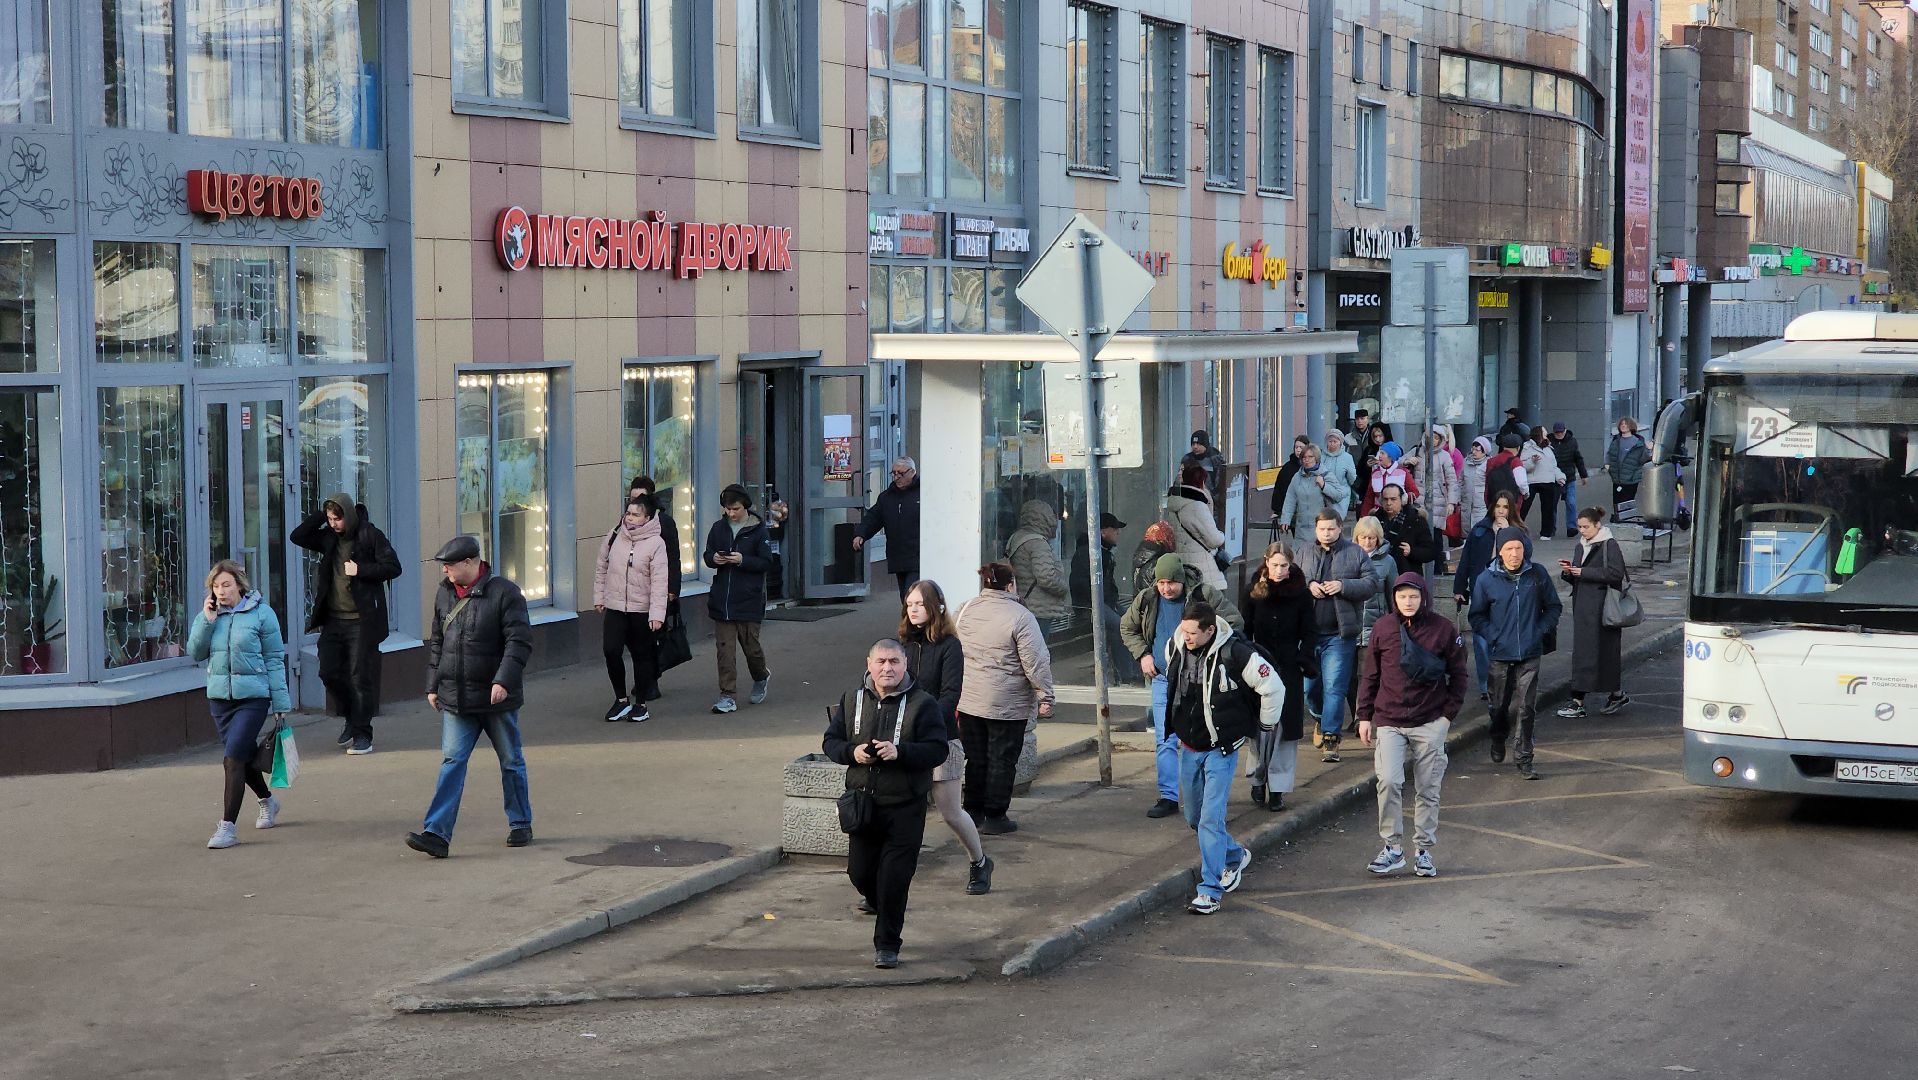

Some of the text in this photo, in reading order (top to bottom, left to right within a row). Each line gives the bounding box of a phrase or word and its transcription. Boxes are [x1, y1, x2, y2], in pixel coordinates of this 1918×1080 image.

[537, 210, 793, 279] МЯСНОЙ ДВОРИК
[998, 227, 1030, 252] ТАБАК
[1522, 244, 1550, 266] ОКНА
[1340, 294, 1380, 307] ПРЕСС
[1751, 416, 1778, 439] 23
